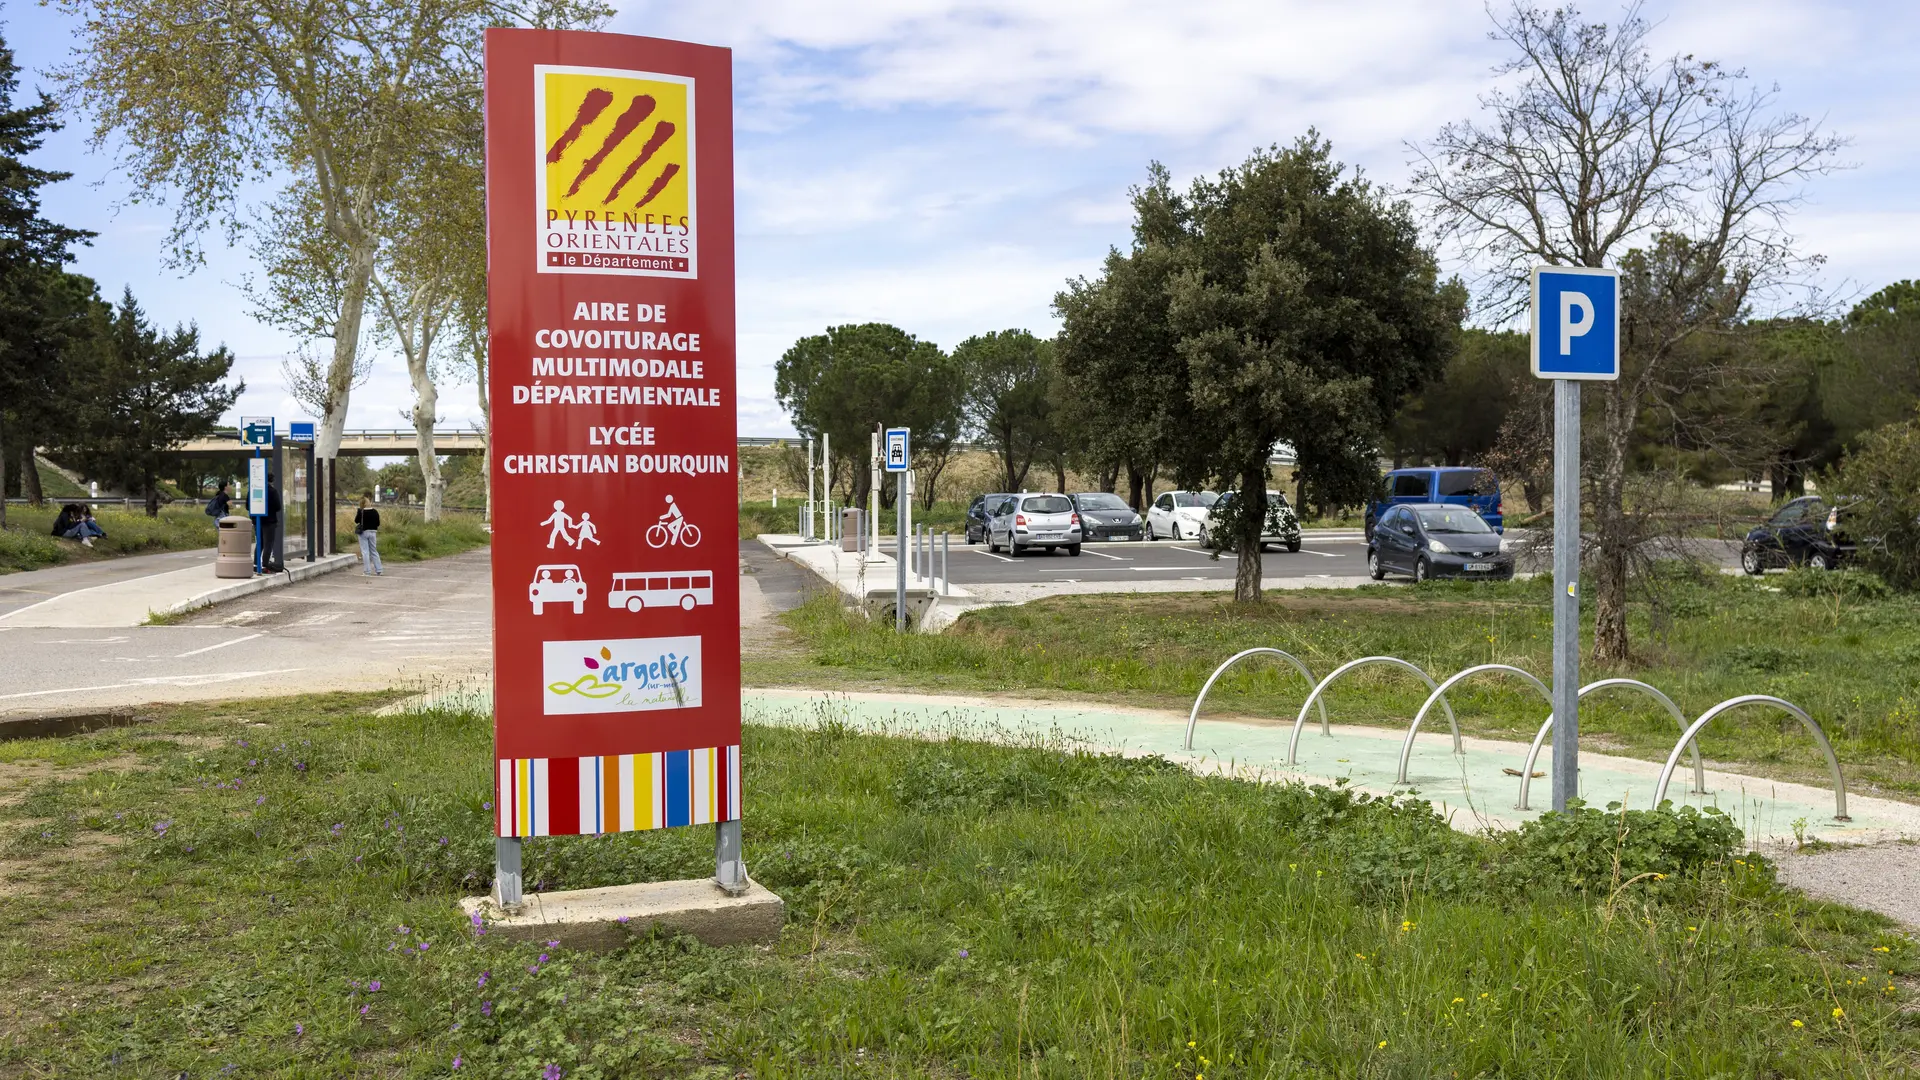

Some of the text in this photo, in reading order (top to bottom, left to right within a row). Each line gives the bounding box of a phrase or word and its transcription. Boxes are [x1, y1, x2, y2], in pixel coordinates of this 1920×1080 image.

[547, 232, 689, 254] ORIENTALES
[563, 253, 674, 269] le Département
[573, 302, 667, 323] AIRE DE
[1559, 291, 1595, 355] P
[535, 329, 701, 352] COVOITURAGE
[532, 357, 704, 379] MULTIMODALE
[512, 380, 721, 407] DÉPARTEMENTALE
[589, 422, 656, 446] LYCÉE
[503, 455, 729, 478] CHRISTIAN BOURQUIN
[603, 653, 689, 690] argelès
[616, 692, 639, 706] la
